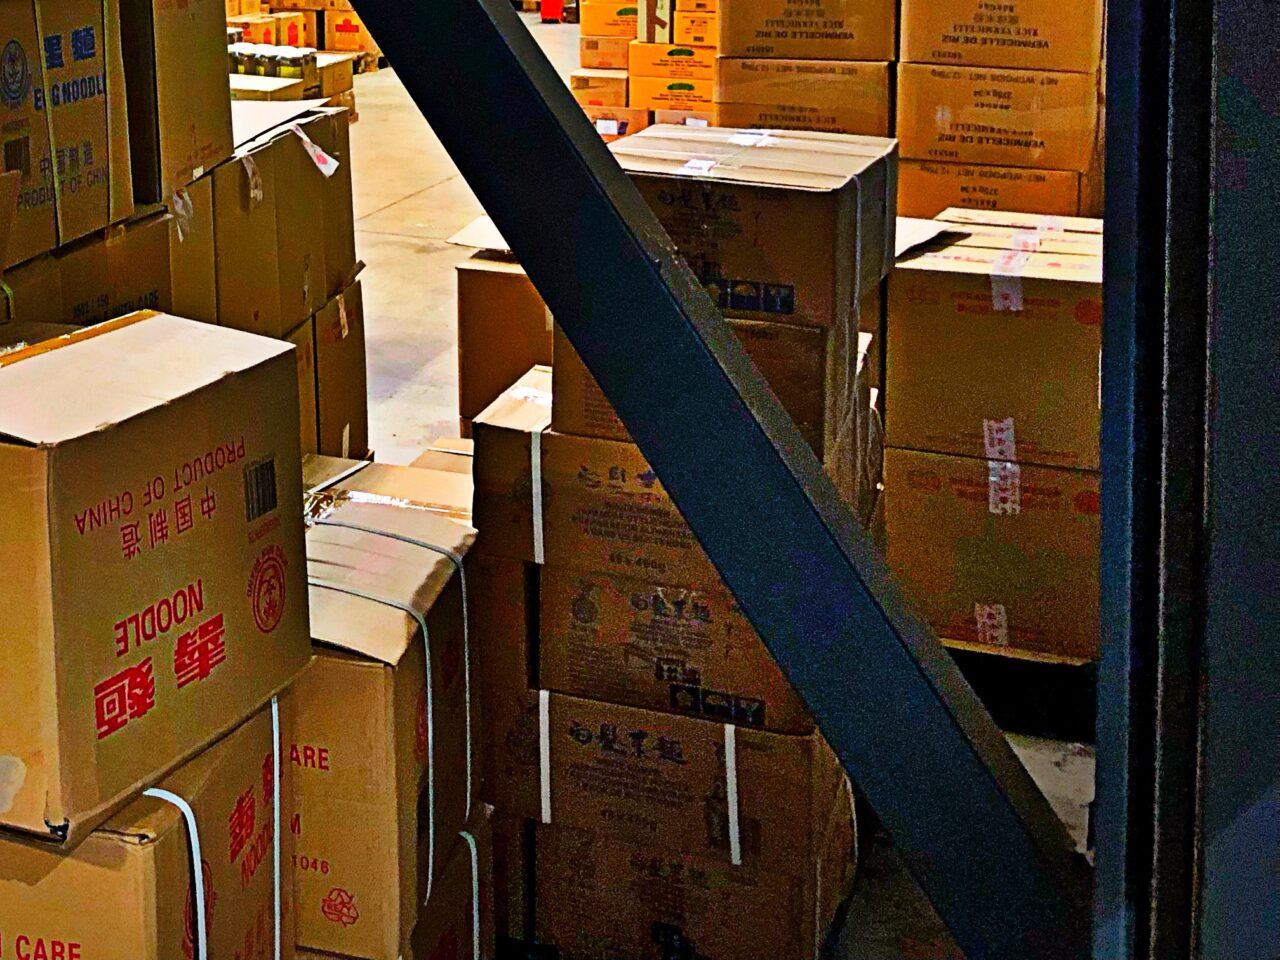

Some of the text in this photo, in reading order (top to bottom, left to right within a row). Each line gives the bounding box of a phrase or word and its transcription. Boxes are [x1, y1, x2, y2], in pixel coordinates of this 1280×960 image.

[775, 30, 788, 39] DE
[791, 30, 854, 40] VERMICELLE
[941, 35, 1049, 49] VERMICELLE DE RIZ
[33, 84, 60, 111] EG
[938, 134, 1045, 149] VERMICELLE DE RIZ
[74, 435, 246, 535] PRODUCT OF CHINA
[121, 486, 217, 560] 中国制造
[114, 578, 206, 659] NOODLE
